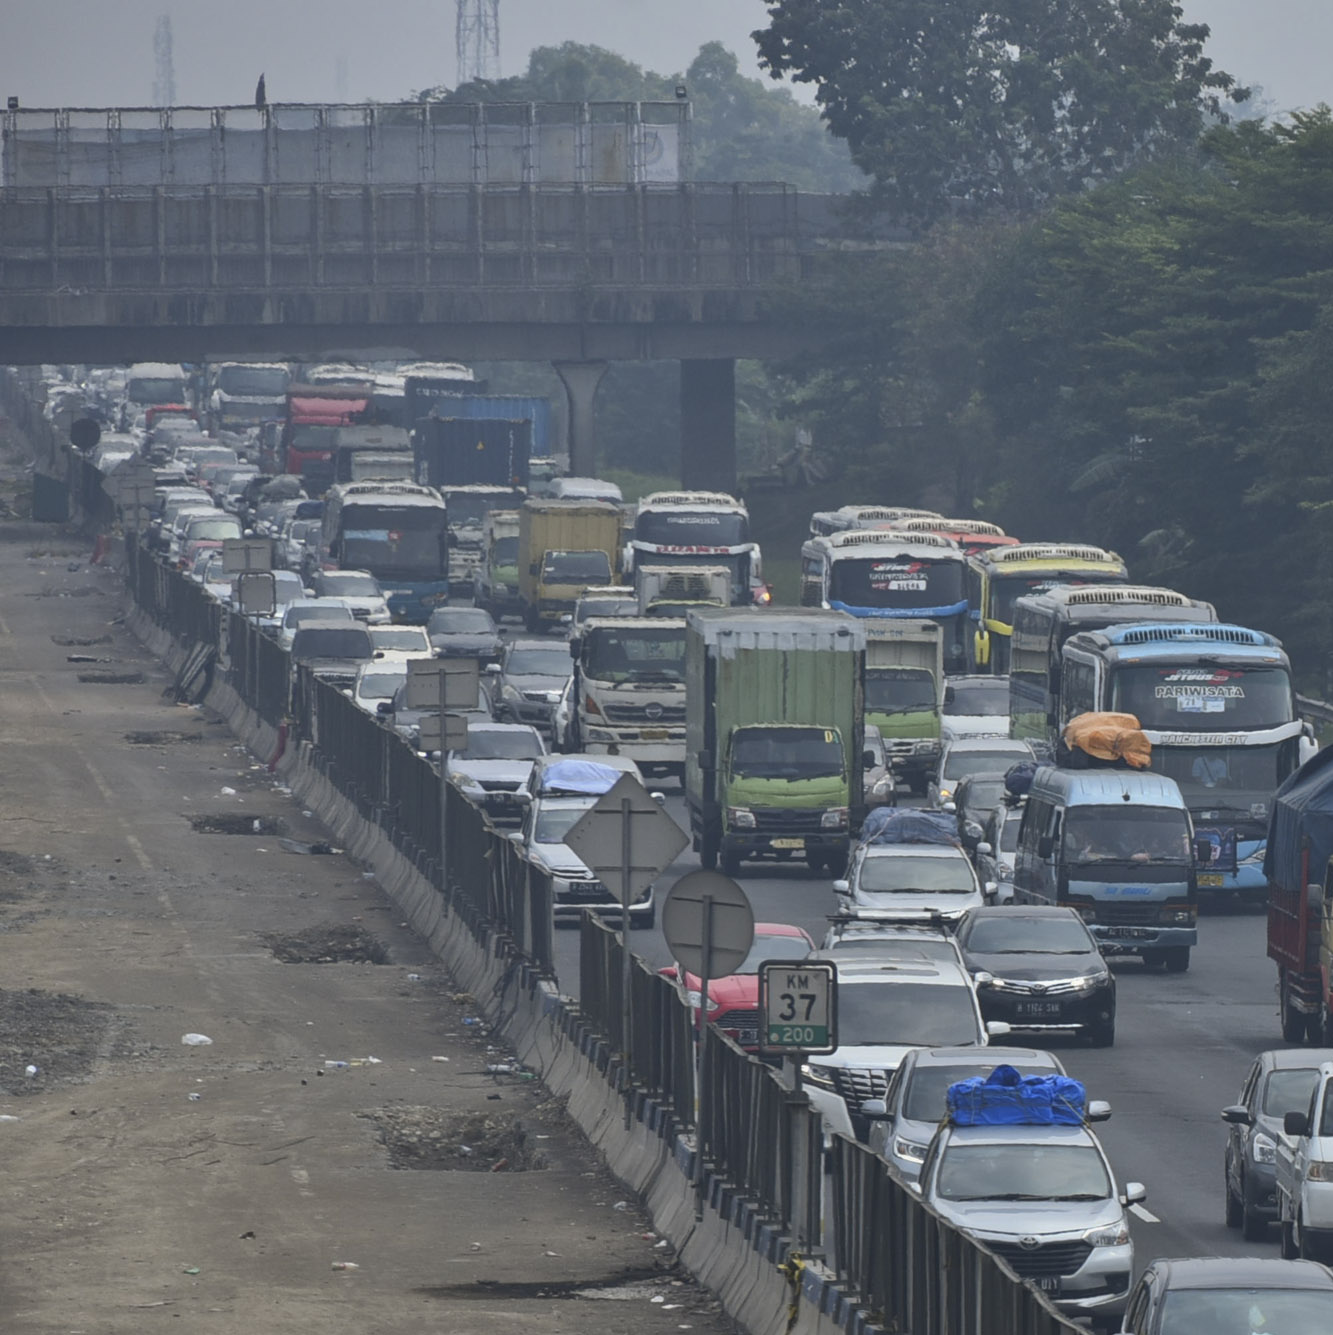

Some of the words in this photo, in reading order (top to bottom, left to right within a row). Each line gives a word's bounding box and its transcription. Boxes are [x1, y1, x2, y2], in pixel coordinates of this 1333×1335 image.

[1155, 686, 1245, 698] PARIWISATA
[786, 974, 809, 989] KM
[779, 993, 817, 1022] 37
[782, 1027, 814, 1042] 200
